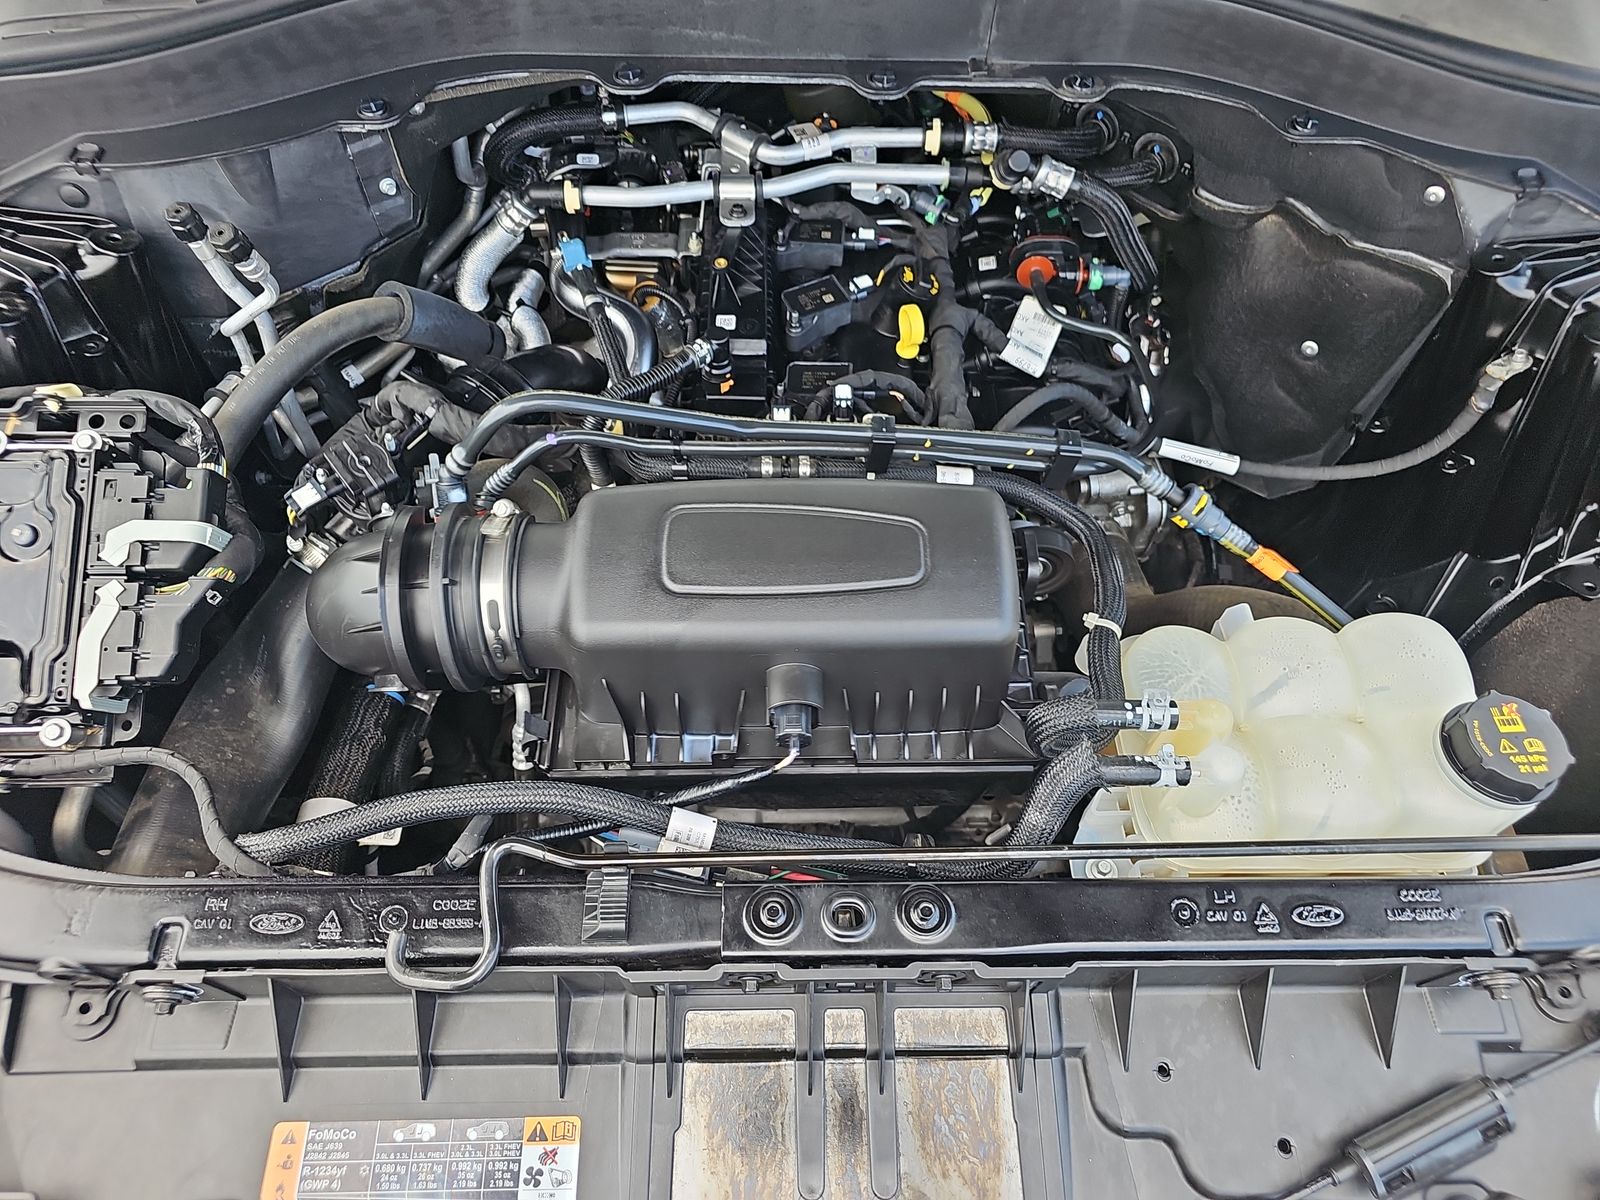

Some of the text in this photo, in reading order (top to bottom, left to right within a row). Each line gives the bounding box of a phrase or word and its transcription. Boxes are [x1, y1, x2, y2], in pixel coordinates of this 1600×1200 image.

[1180, 454, 1214, 467] FoMoCo
[204, 897, 228, 911] RH
[255, 913, 304, 932] Ford
[307, 1128, 357, 1140] FoMoCo
[306, 1142, 343, 1150] SAE J639
[305, 1152, 327, 1160] J2842
[303, 1165, 347, 1177] R-1234yf
[375, 1163, 406, 1174] 0.680 kg
[411, 1163, 443, 1174] 0.737 kg
[451, 1161, 482, 1172] 0.992 kg
[488, 1161, 519, 1172] 0.992 kg
[380, 1174, 389, 1182] 24
[494, 1171, 503, 1179] 35
[301, 1179, 341, 1191] (GWP 4)
[390, 1182, 400, 1190] lbs
[427, 1181, 437, 1189] lbs
[452, 1180, 477, 1188] 2.19 lbs
[504, 1179, 514, 1187] lbs
